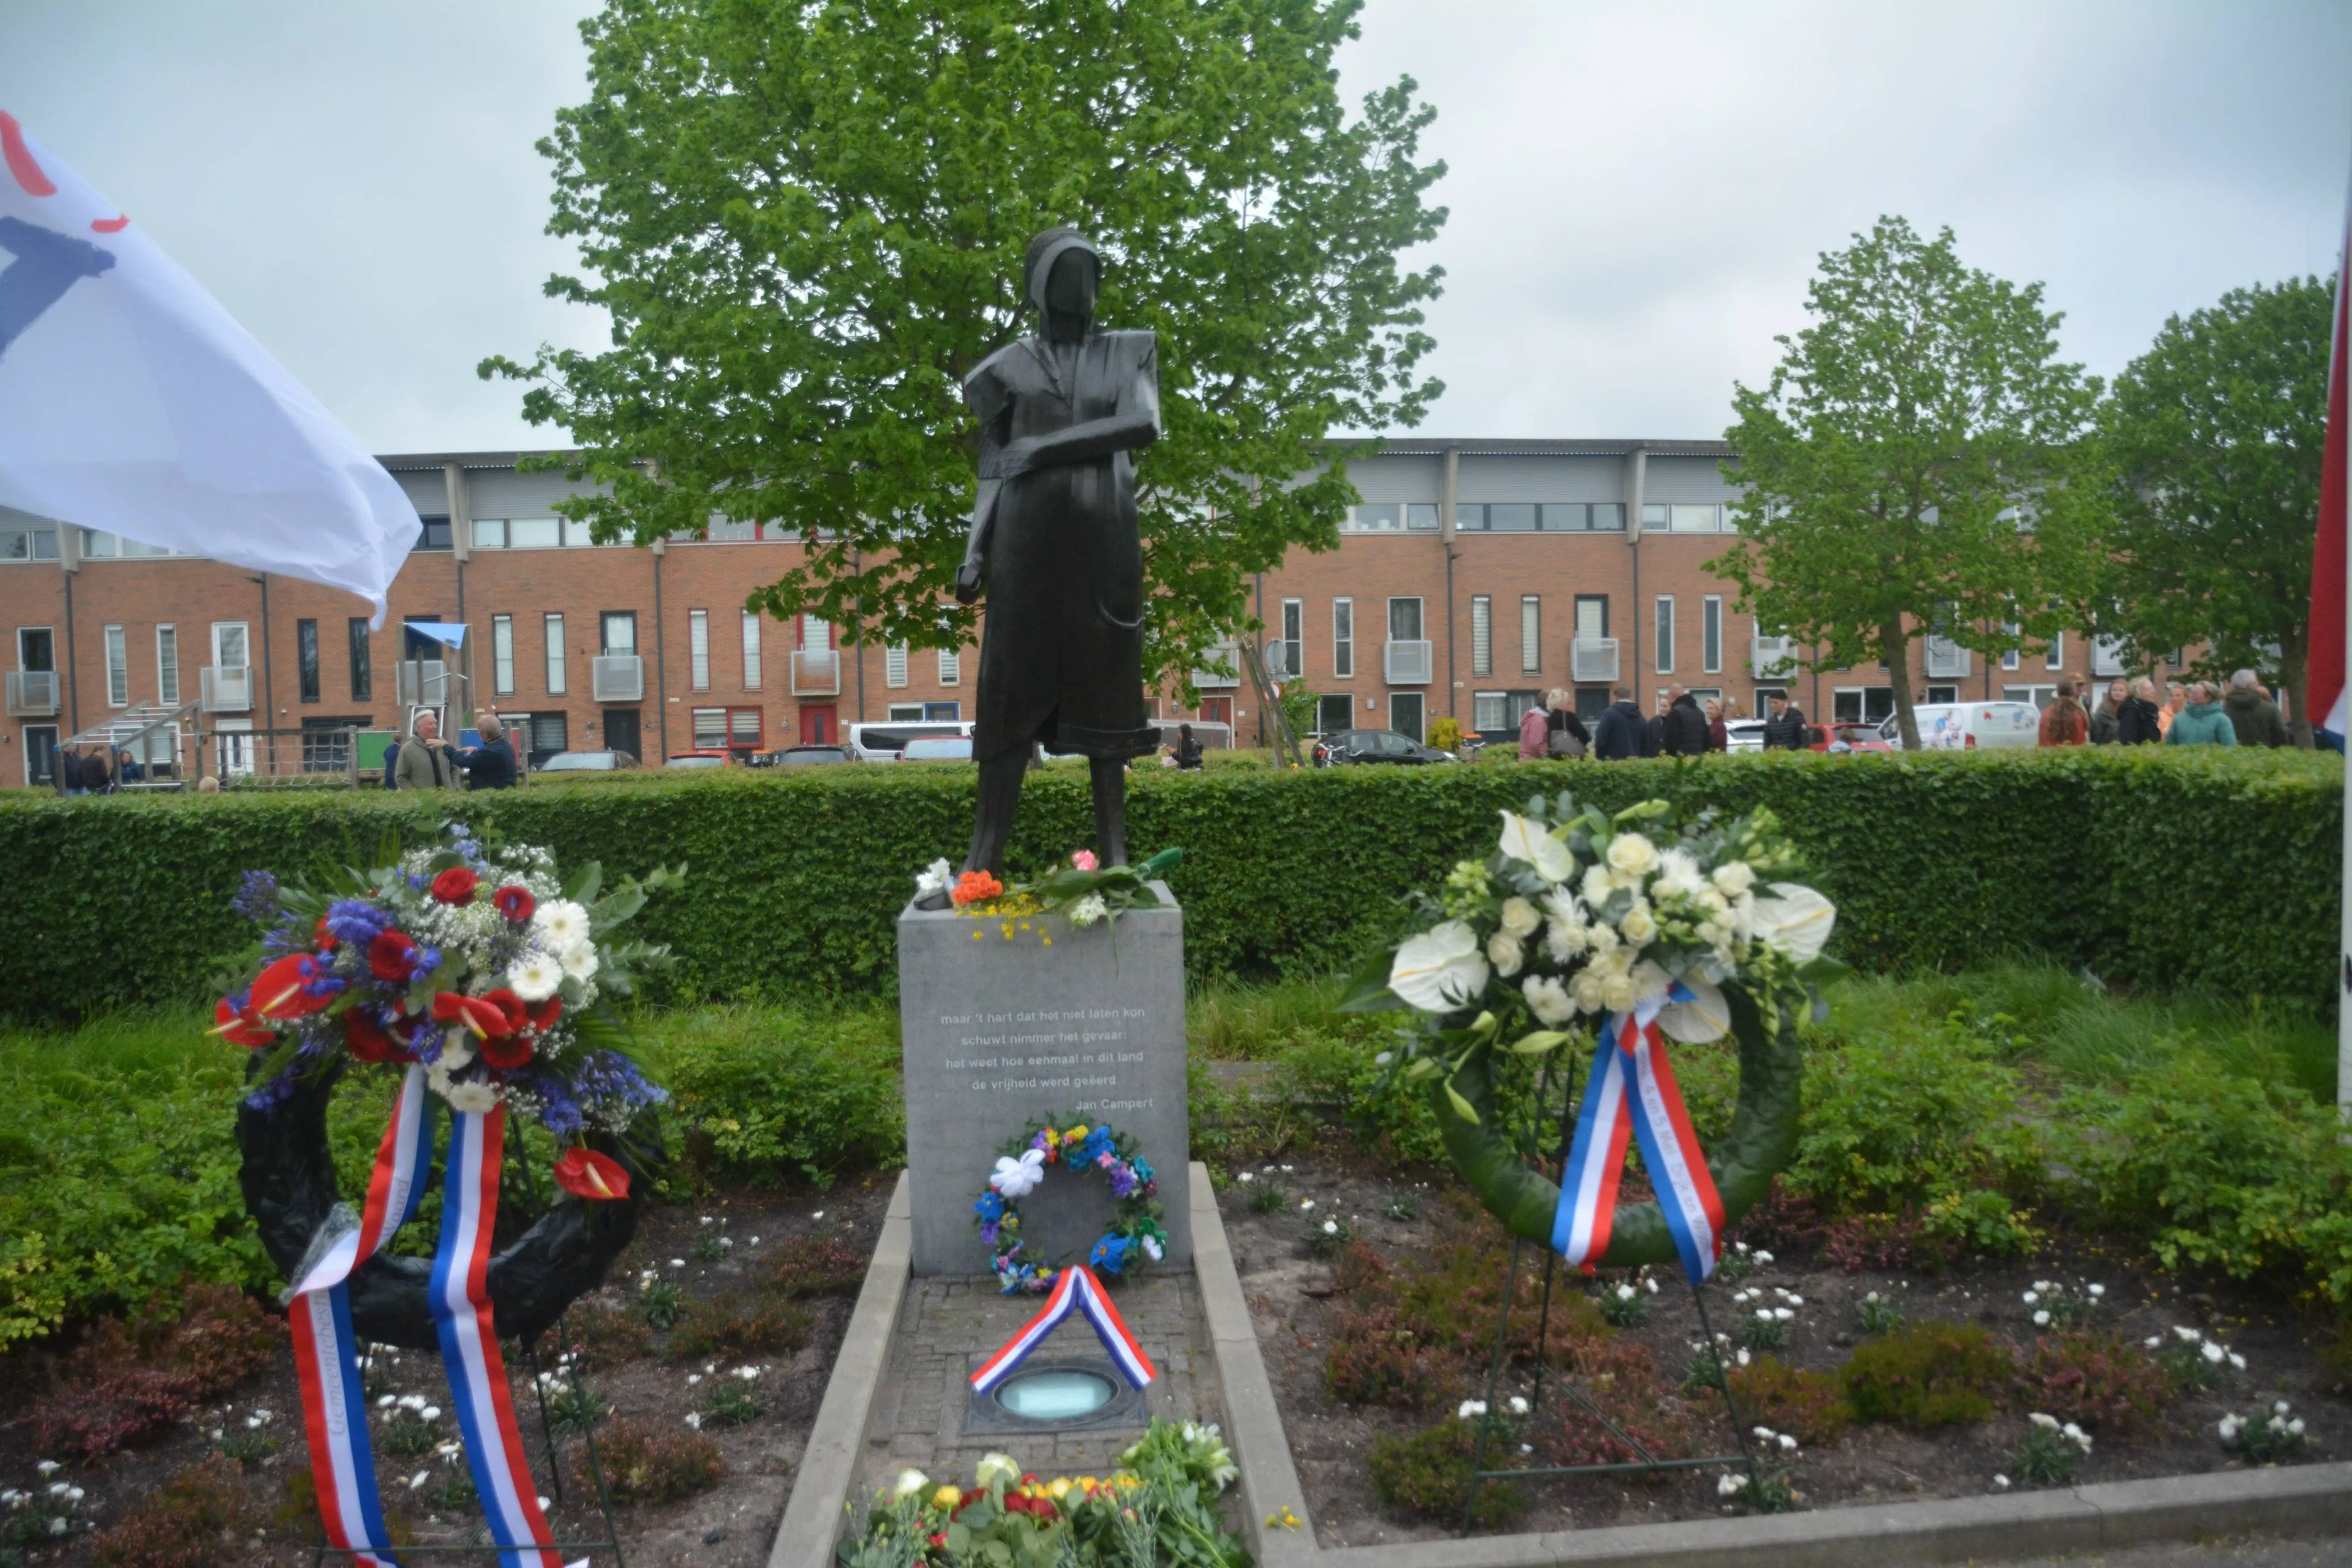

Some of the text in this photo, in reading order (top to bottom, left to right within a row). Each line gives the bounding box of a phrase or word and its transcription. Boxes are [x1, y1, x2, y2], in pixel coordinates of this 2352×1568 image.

[941, 1008, 1145, 1025] maar 't hart dat het niet laten kon
[961, 1031, 1127, 1046] schuwt nimmer het gevaar:
[946, 1050, 1144, 1069] het weet hoe eenmaal in dit land
[972, 1079, 987, 1090] de
[990, 1077, 1036, 1091] vrijheid
[1040, 1076, 1070, 1087] werd
[1076, 1098, 1153, 1110] Jan Campert
